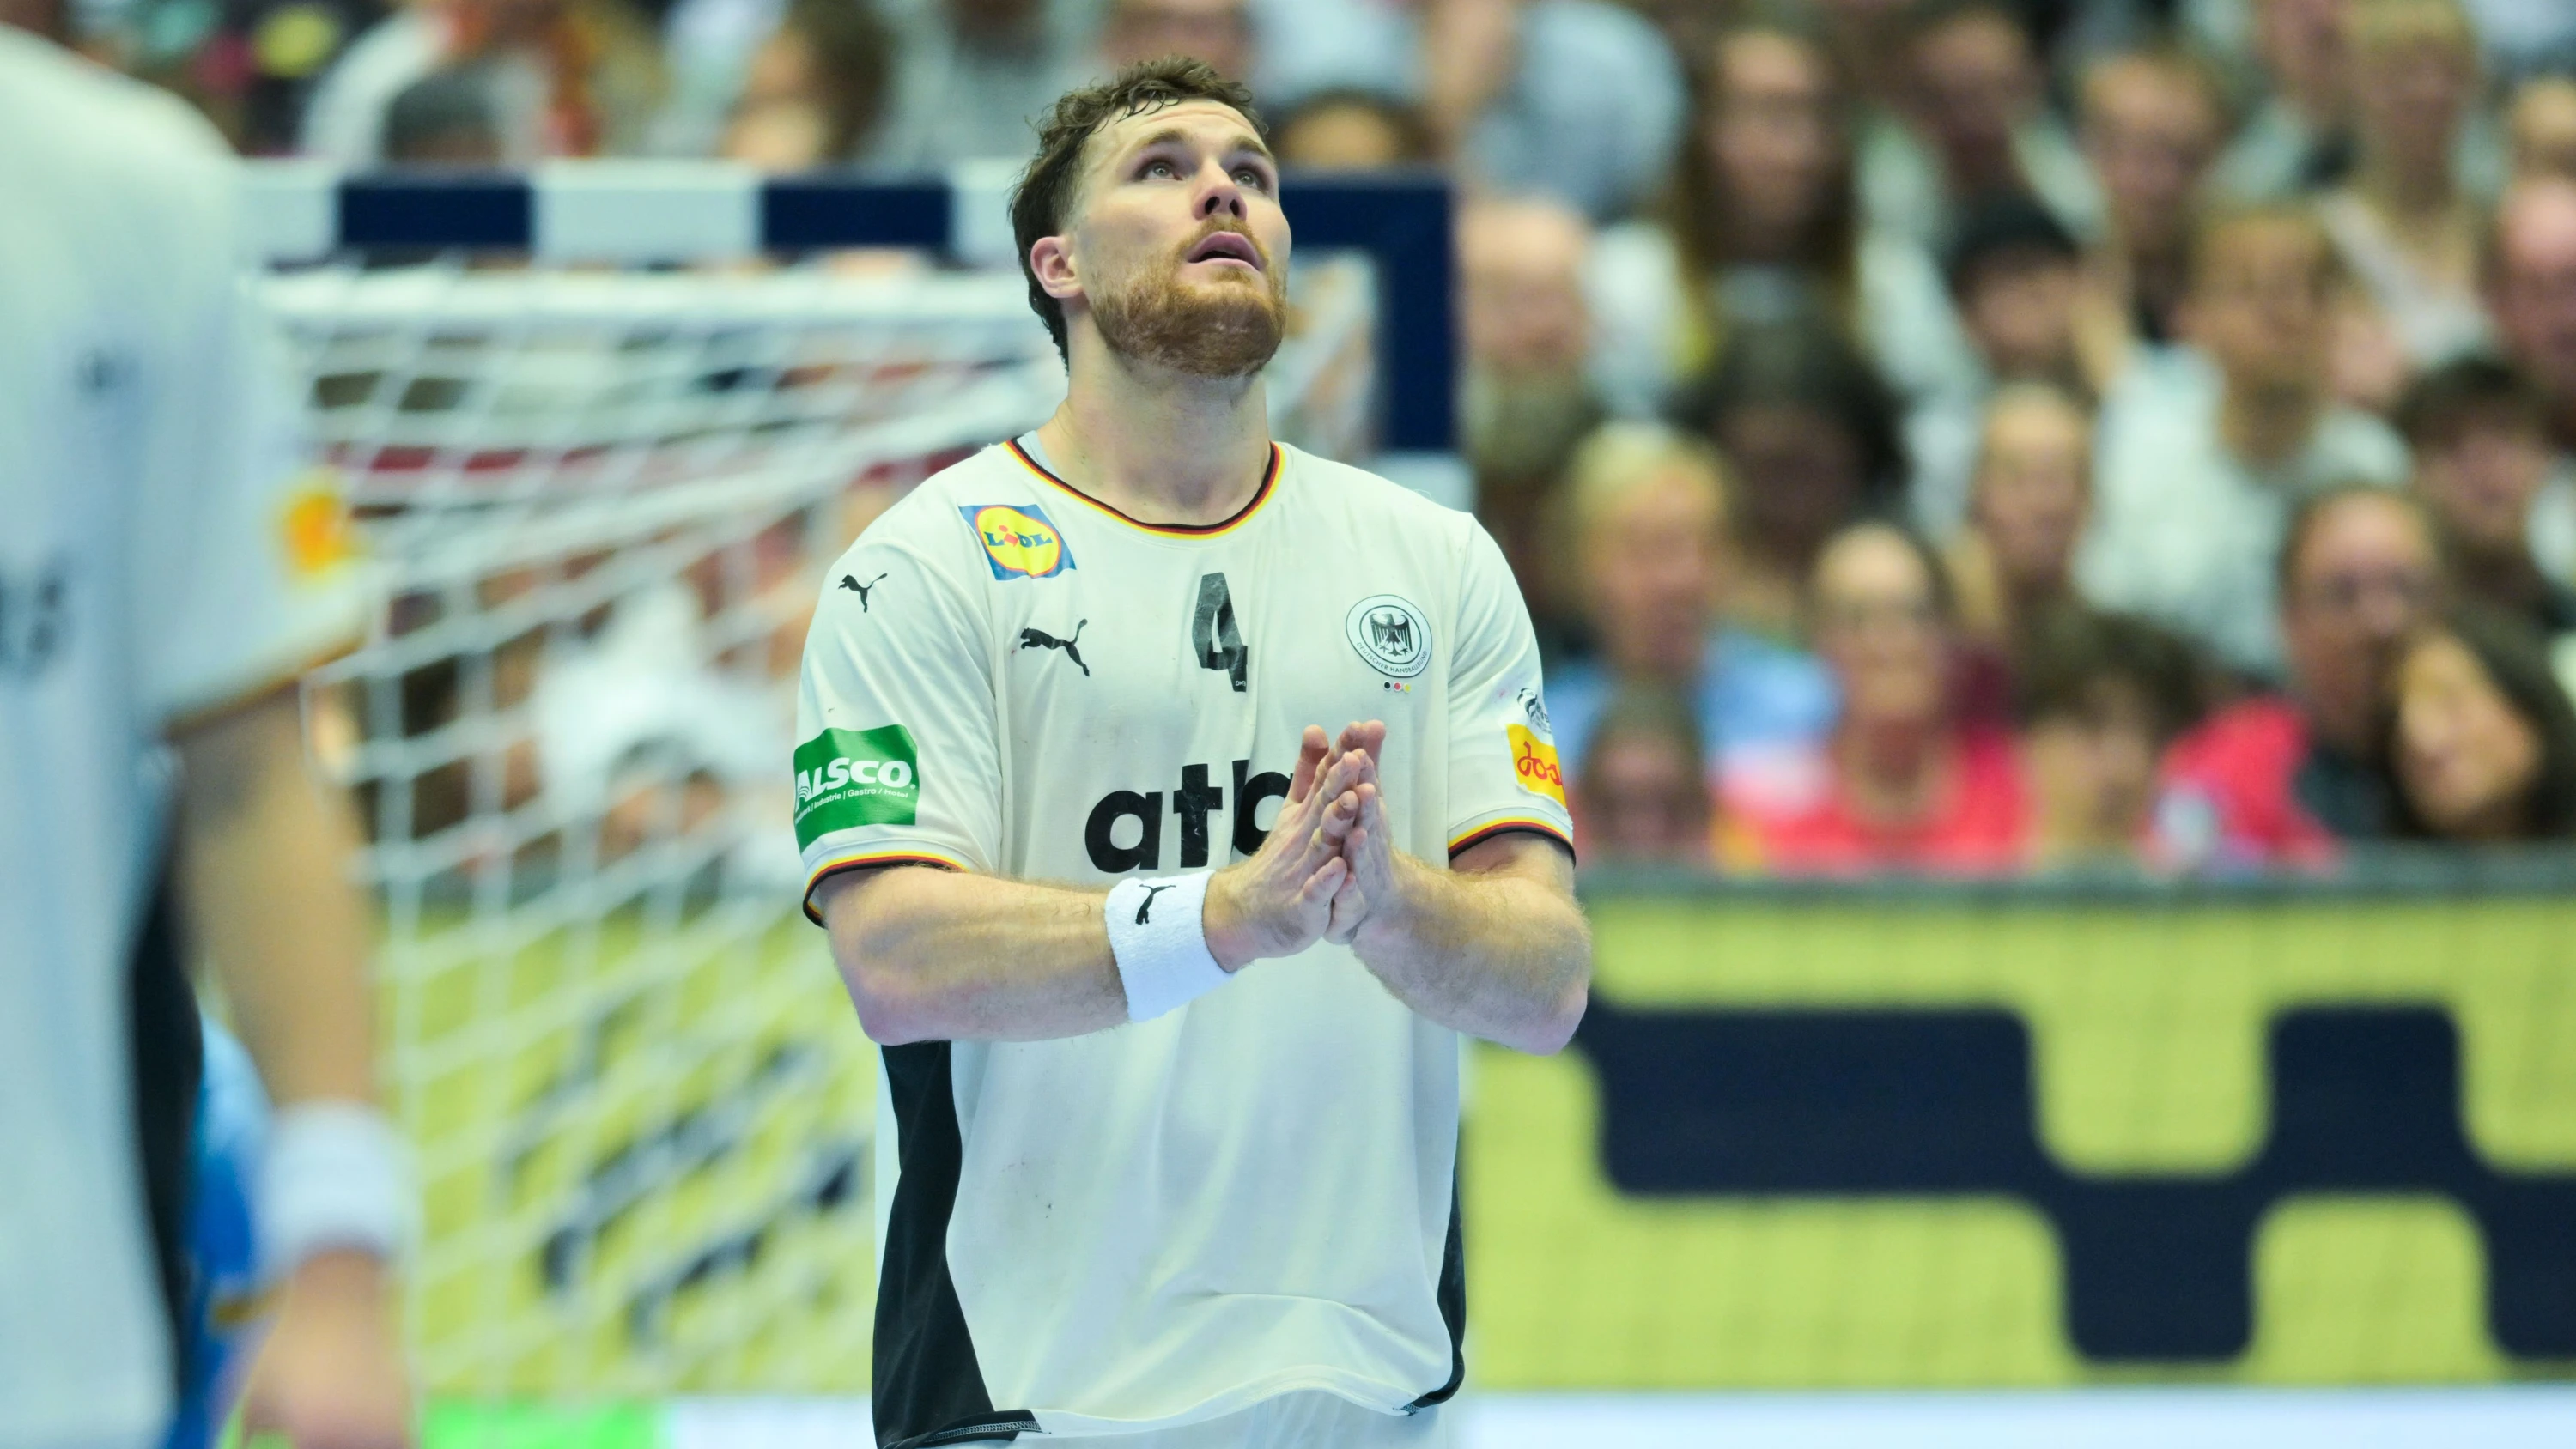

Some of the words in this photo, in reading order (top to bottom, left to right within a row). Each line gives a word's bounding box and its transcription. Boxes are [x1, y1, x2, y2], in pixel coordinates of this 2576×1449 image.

[1191, 572, 1248, 692] 4
[1356, 641, 1388, 670] DEUTSCHER
[794, 757, 913, 813] ALSCO
[813, 792, 841, 809] Industrie
[848, 789, 877, 797] Gastro
[884, 788, 908, 798] Hotel
